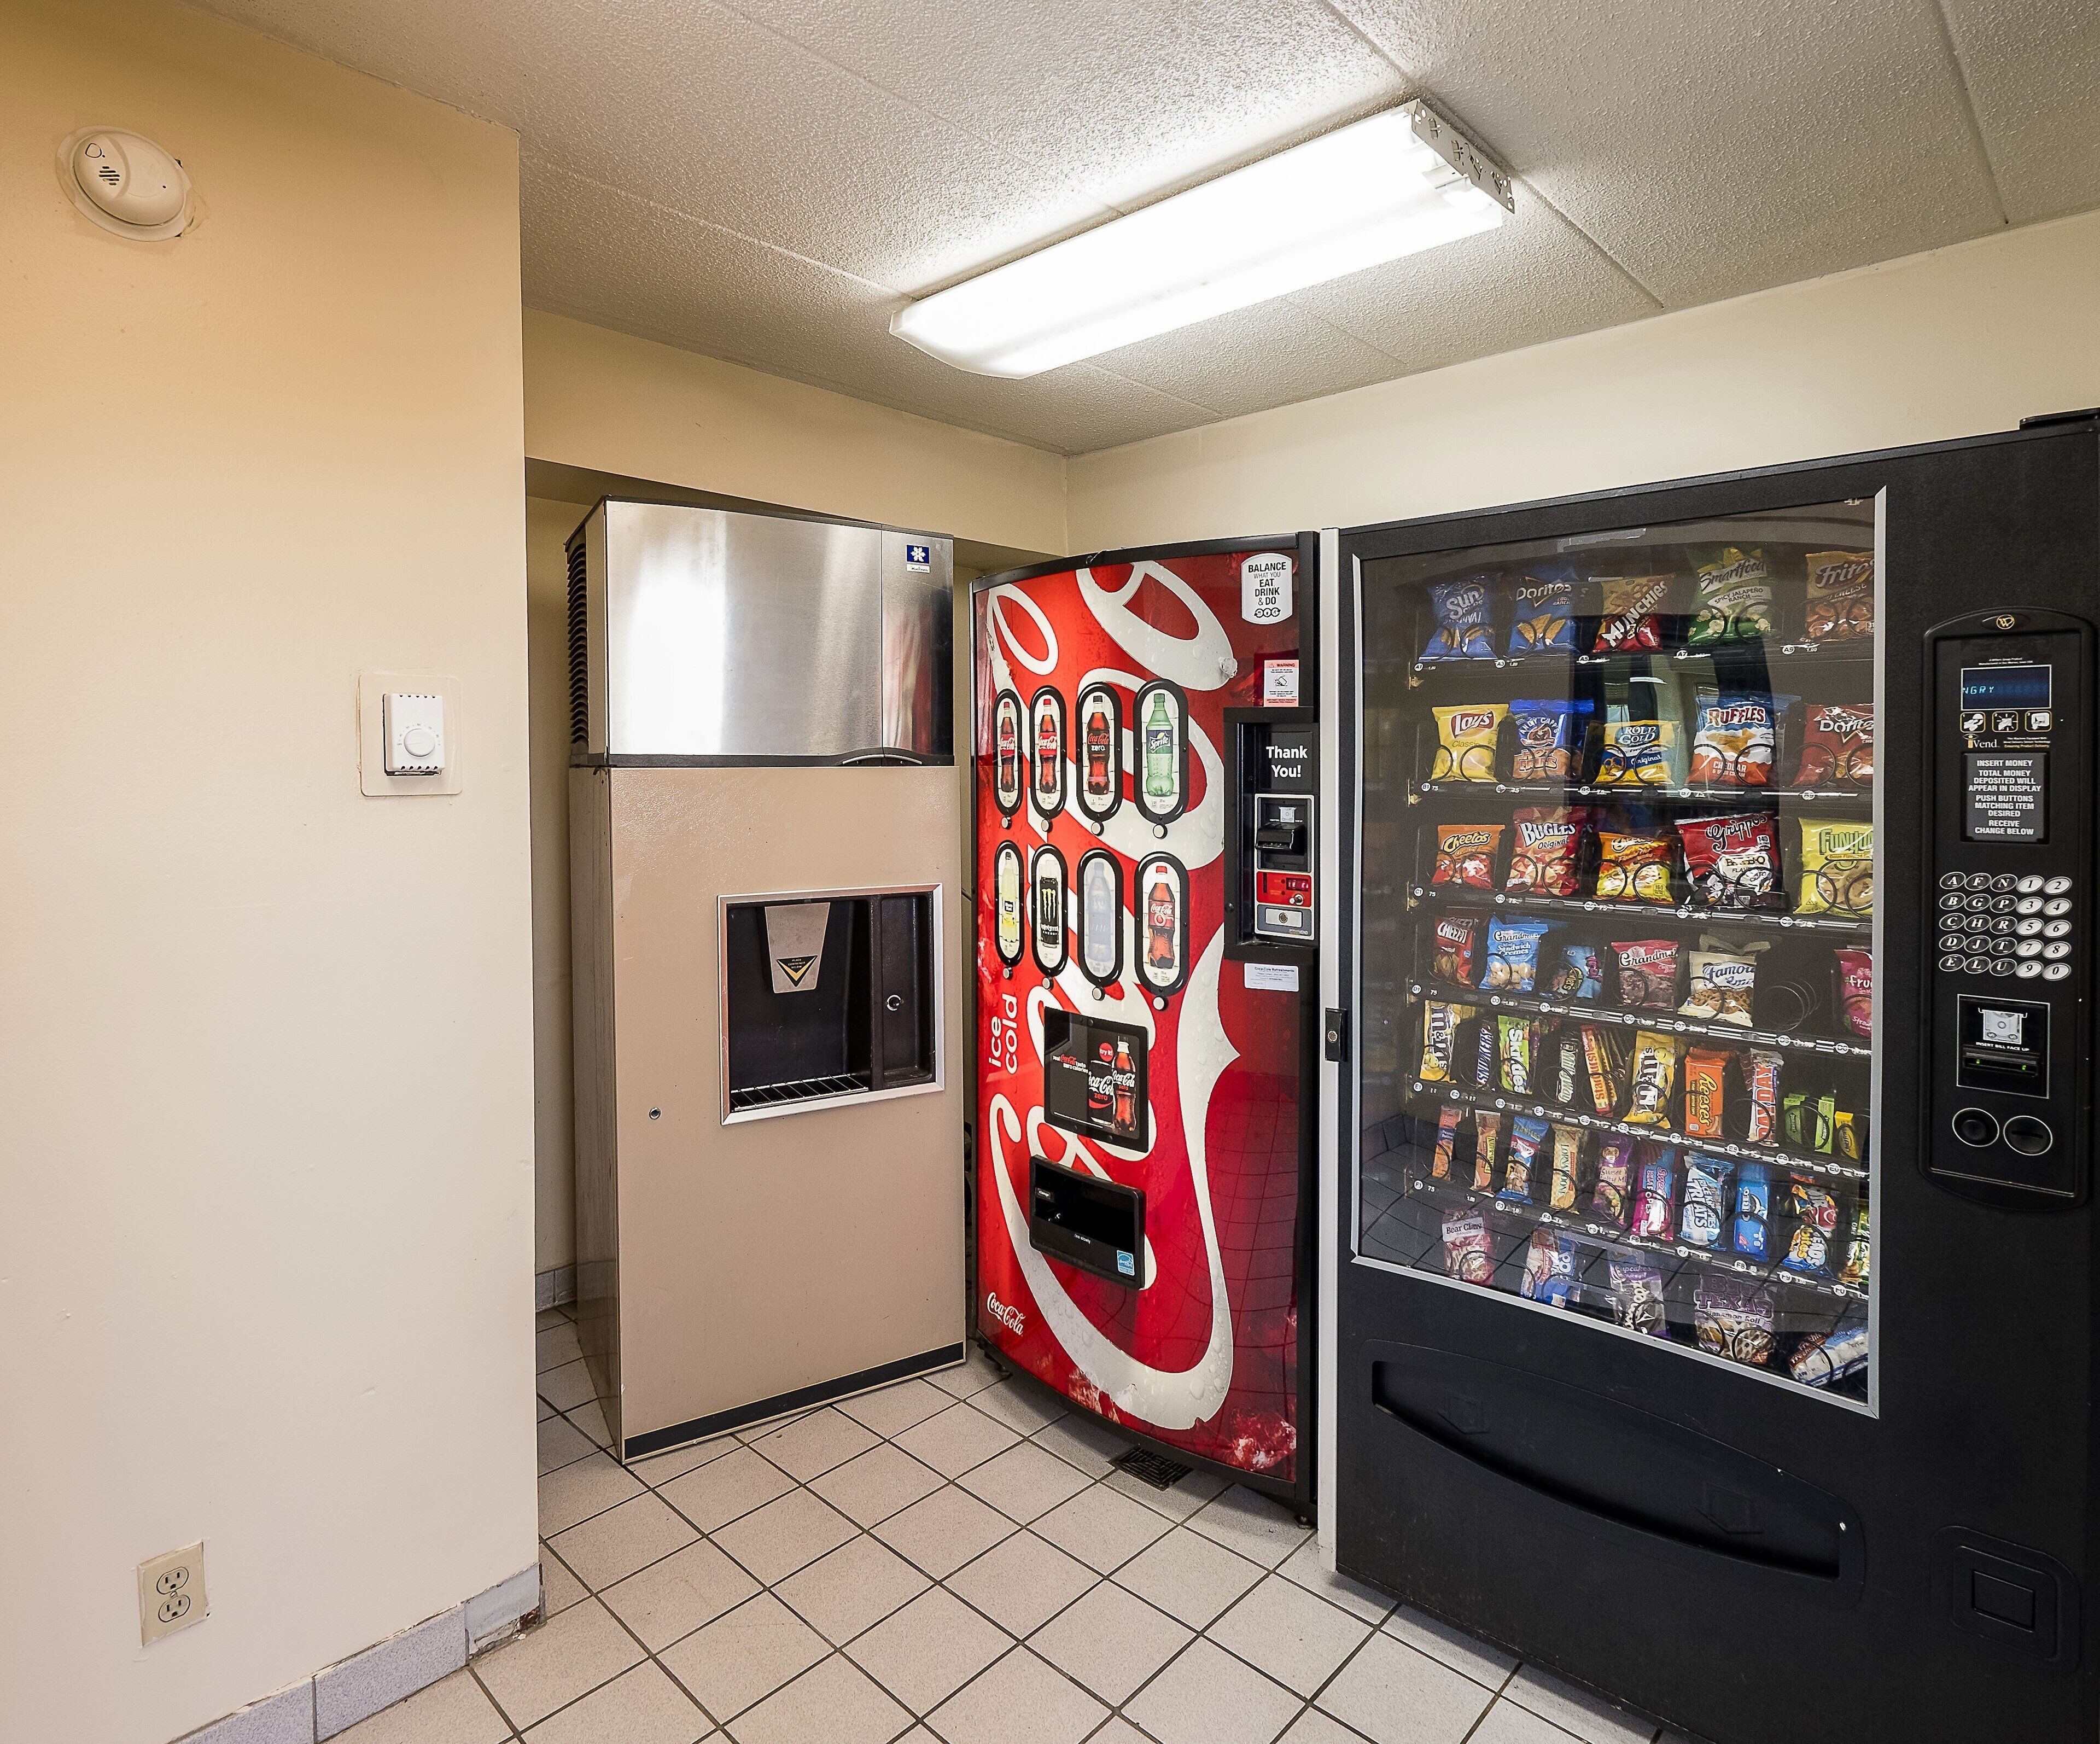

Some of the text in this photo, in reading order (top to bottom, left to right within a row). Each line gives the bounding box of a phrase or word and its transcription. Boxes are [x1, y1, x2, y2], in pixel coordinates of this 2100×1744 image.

[1248, 562, 1286, 573] BALANCE
[1255, 587, 1280, 597] DRINK
[1516, 583, 1572, 601] Doritos
[1729, 594, 1750, 602] RANCH
[1265, 597, 1276, 605] DO
[1707, 707, 1766, 727] RUFFLES
[1625, 726, 1656, 735] ROLD
[1150, 736, 1170, 753] Sprite
[1618, 733, 1656, 745] GOLD
[1266, 745, 1308, 759] Thank
[1521, 748, 1554, 759] HOT
[1271, 765, 1302, 778] You!
[1519, 822, 1576, 847] BUGLES
[1443, 831, 1491, 854] Cheetos
[1947, 876, 1958, 884] A
[1973, 877, 1983, 885] F
[1998, 879, 2009, 887] N
[2054, 882, 2061, 890] 2
[1948, 897, 1958, 905] B
[1998, 900, 2009, 908] P
[2026, 901, 2033, 909] 3
[1971, 919, 1983, 927] H
[1997, 921, 2009, 929] R
[2027, 922, 2034, 930] 5
[2053, 924, 2060, 932] 6
[1497, 942, 1531, 953] Sandwich
[1498, 948, 1529, 956] Cremes
[1946, 937, 2060, 954] D J T 7 8
[1946, 958, 1957, 966] E
[1972, 960, 1982, 969] L
[1997, 962, 2007, 971] U
[2026, 964, 2033, 972] 9
[1706, 964, 1754, 981] Famou
[1850, 975, 1872, 988] Fru
[1002, 993, 1017, 1074] cold
[989, 1016, 1002, 1068] ice
[1477, 1028, 1493, 1085] SNICKERS
[1509, 1028, 1526, 1094] Skittles
[1094, 1093, 1108, 1101] zero
[1698, 1071, 1718, 1127] Reese's
[1446, 1226, 1461, 1234] Bear
[1695, 1291, 1773, 1319] TEXAS
[987, 1292, 1026, 1337] Coca-Cola
[1708, 1310, 1760, 1325] innamon Roll
